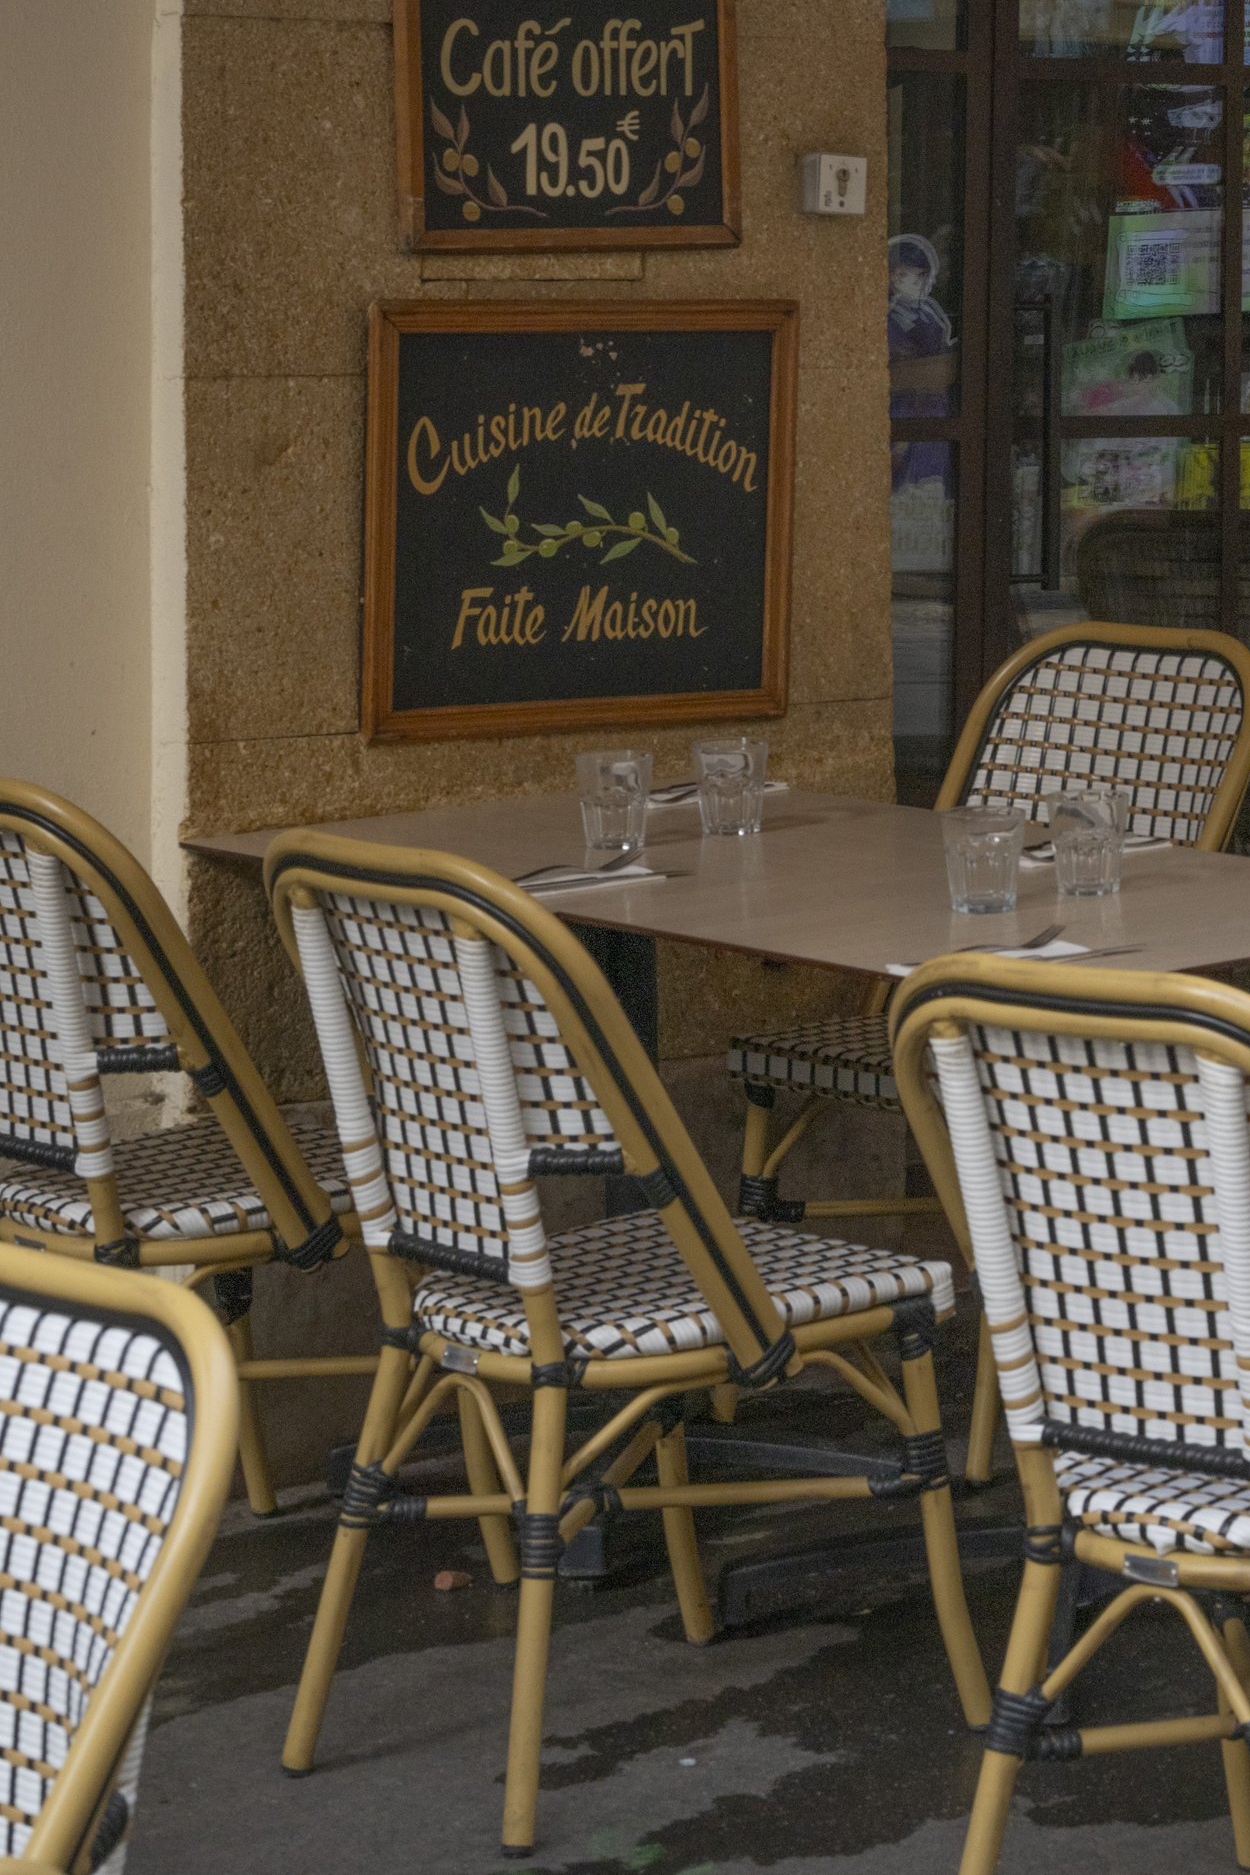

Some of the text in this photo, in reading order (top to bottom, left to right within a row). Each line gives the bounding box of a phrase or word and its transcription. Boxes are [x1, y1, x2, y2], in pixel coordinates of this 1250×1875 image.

[440, 14, 706, 98] Café offert
[407, 383, 759, 495] Cuisine de Tradition
[451, 585, 709, 650] Faite Maison
